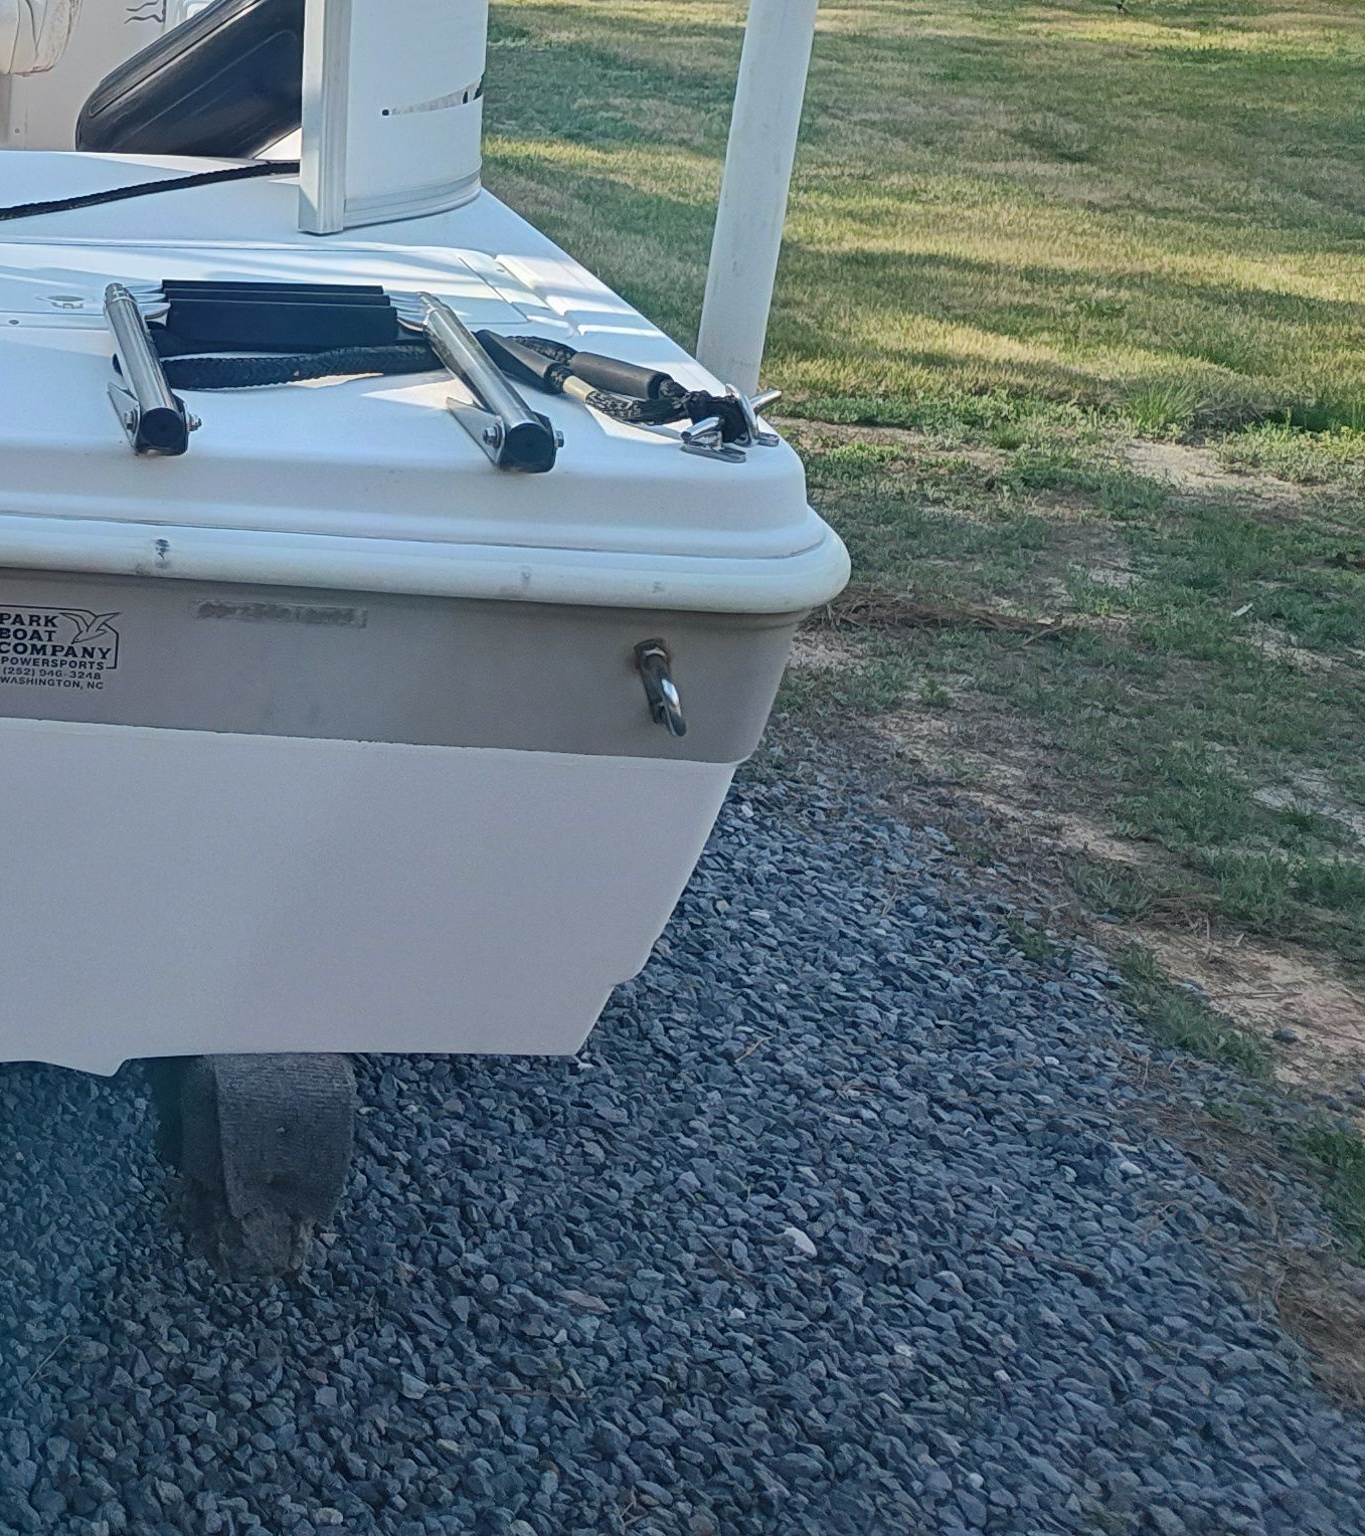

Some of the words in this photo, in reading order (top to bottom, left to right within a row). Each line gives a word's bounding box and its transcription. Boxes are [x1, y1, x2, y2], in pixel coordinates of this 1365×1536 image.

[0, 655, 105, 671] POWERSPORTS
[2, 666, 36, 677] (252)
[0, 675, 84, 690] WASHINGTON,
[86, 680, 104, 690] NC
